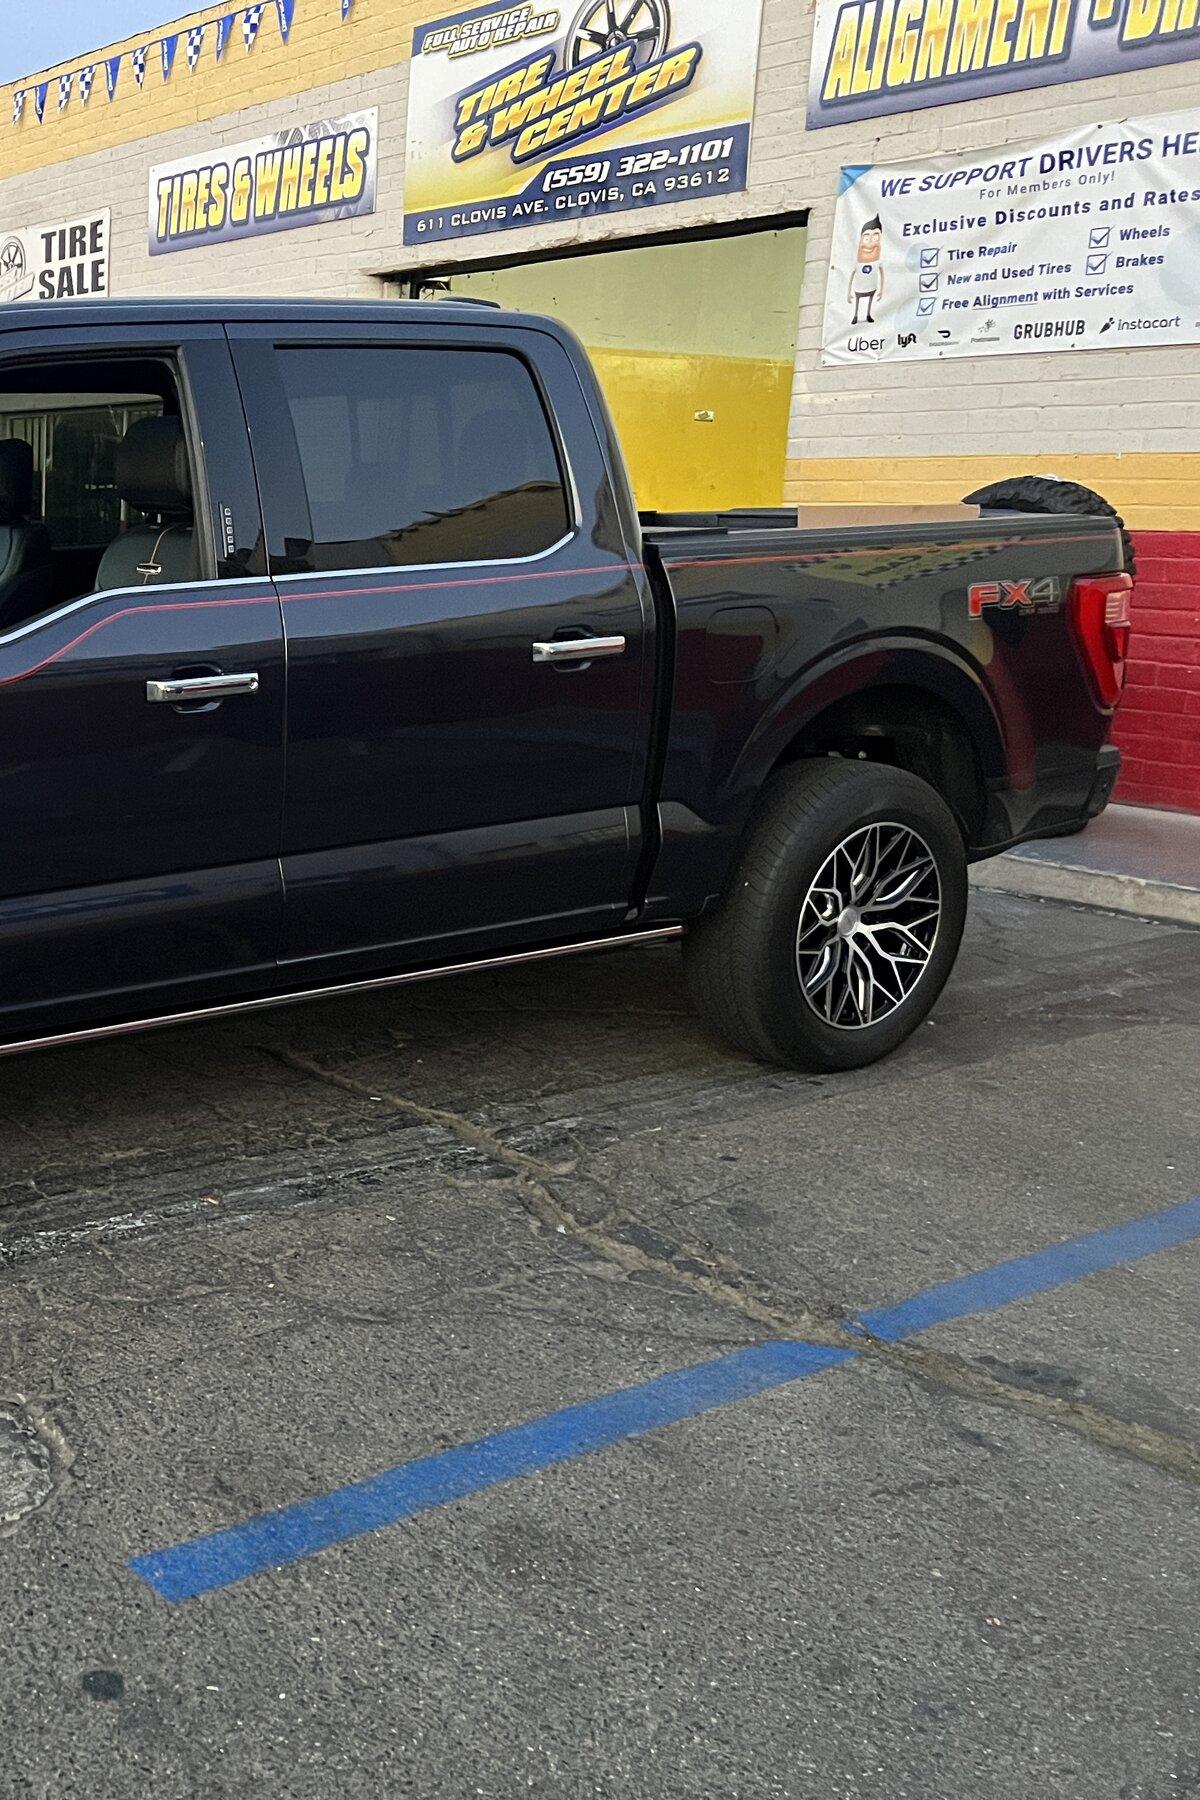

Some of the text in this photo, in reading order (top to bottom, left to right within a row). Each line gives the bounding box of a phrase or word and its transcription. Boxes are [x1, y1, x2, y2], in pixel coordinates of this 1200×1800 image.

[423, 7, 531, 50] FULL SERVICE
[449, 12, 558, 55] AUTO REPAIR
[456, 54, 555, 127] TIRE
[456, 46, 632, 156] & WHEEL
[513, 47, 698, 158] CENTER
[156, 129, 369, 239] TIRES & WHEELS
[542, 137, 734, 193] (559) 322-1101
[881, 131, 1200, 198] WE SUPPORT DRIVERS HE
[979, 170, 1115, 200] For Members Only!
[417, 168, 730, 232] 611 CLOVIS AVE. CLOVIS, CA 93612
[902, 189, 1200, 237] Exclusive Discounts and Rates
[40, 219, 104, 263] TIRE
[948, 242, 1018, 261] Tire Repair
[1119, 225, 1171, 241] Wheels
[38, 258, 105, 300] SALE
[947, 263, 1072, 286] New and Used Tires
[1115, 253, 1165, 269] Brakes
[941, 283, 1135, 310] Free Alignment with Services
[847, 337, 886, 352] Uber
[1013, 319, 1086, 340] GRUBHUB
[1117, 315, 1182, 331] instacart
[968, 576, 1060, 620] FX4
